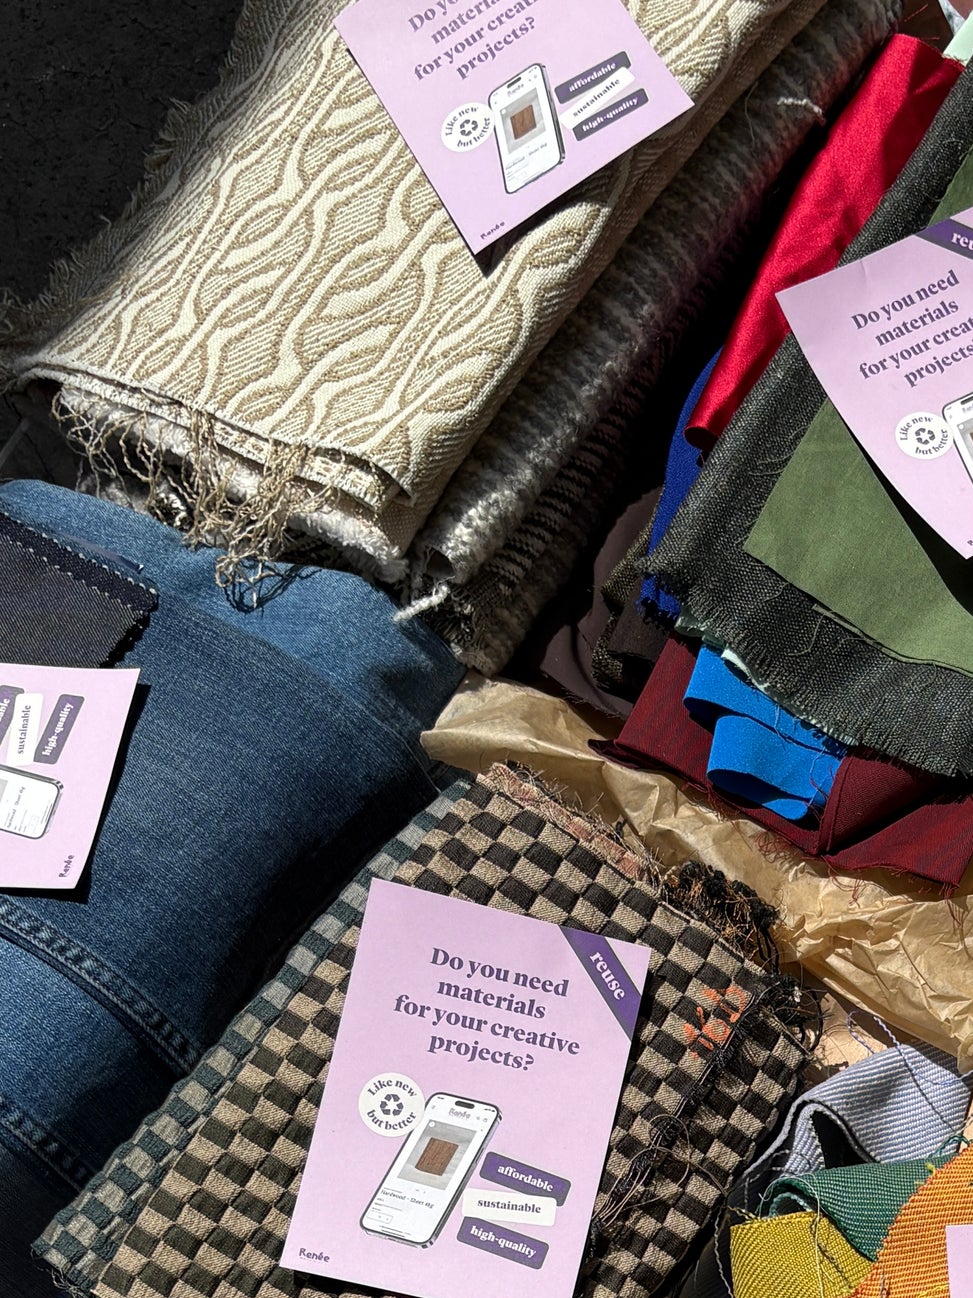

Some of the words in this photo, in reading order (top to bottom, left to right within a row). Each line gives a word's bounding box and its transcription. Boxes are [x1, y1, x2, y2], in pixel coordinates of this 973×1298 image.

[408, 8, 436, 32] Do
[414, 56, 442, 80] for
[443, 27, 484, 64] your
[487, 0, 538, 31] creat
[456, 16, 535, 80] projects?
[569, 63, 615, 92] affordable
[572, 79, 620, 117] sustainable
[582, 98, 637, 131] high-quality
[444, 115, 459, 137] Like
[457, 106, 478, 118] new
[456, 138, 474, 148] but
[472, 116, 491, 143] better
[851, 311, 880, 329] Do
[880, 294, 916, 321] you
[915, 269, 960, 301] need
[875, 300, 959, 346] materials
[859, 358, 888, 379] for
[888, 339, 931, 369] your
[898, 421, 913, 442] Like
[910, 415, 932, 425] new
[914, 446, 933, 456] but
[931, 428, 949, 453] better
[17, 705, 31, 754] sustainable
[42, 703, 74, 756] high-quality
[430, 947, 464, 970] Do
[466, 960, 510, 982] you
[513, 972, 569, 997] need
[590, 952, 625, 1000] reuse
[437, 982, 546, 1019] materials
[394, 994, 431, 1018] for
[432, 1008, 488, 1032] your
[490, 1023, 580, 1055] creative
[427, 1036, 534, 1071] projects?
[366, 1079, 394, 1097] Like
[394, 1079, 418, 1098] new
[366, 1108, 385, 1129] but
[383, 1111, 417, 1131] better
[497, 1166, 553, 1192] affordable
[476, 1200, 542, 1213] sustainable
[470, 1225, 536, 1258] high-quality
